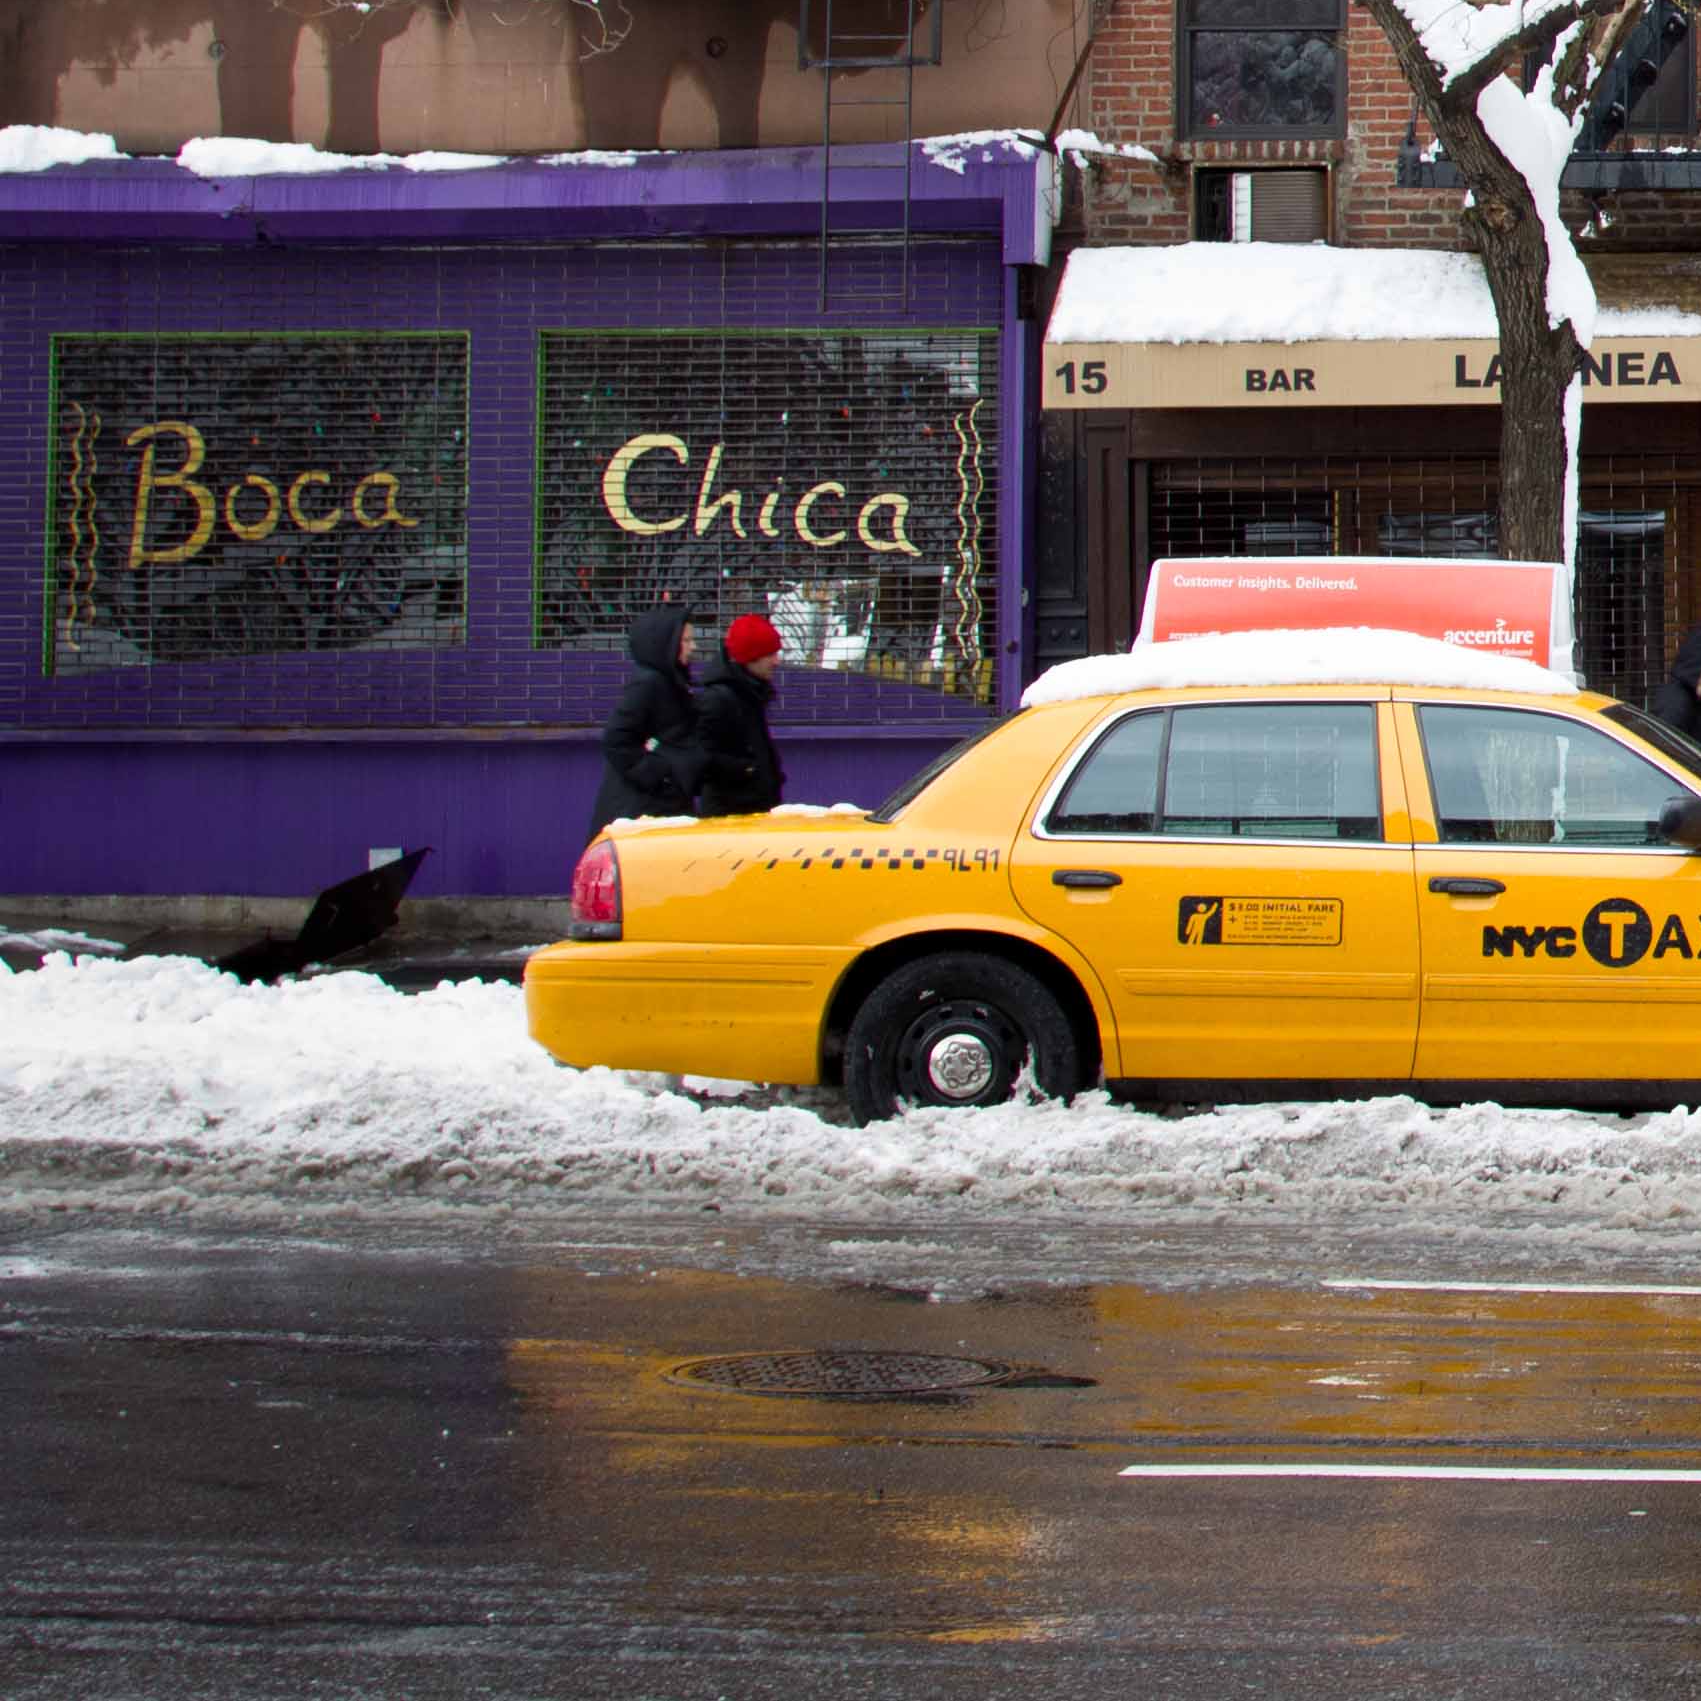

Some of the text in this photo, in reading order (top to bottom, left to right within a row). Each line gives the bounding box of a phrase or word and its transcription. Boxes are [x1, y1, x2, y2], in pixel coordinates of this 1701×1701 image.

[1055, 361, 1108, 394] 15
[1245, 368, 1315, 392] BAR
[1455, 354, 1504, 388] LA
[126, 420, 420, 570] Boca
[603, 433, 923, 557] Chica
[1173, 575, 1359, 592] Customer insights. Delivered.
[1443, 625, 1535, 646] accenture
[1262, 903, 1303, 913] INITIAL
[1307, 903, 1335, 913] FARE
[1482, 925, 1577, 958] NYC
